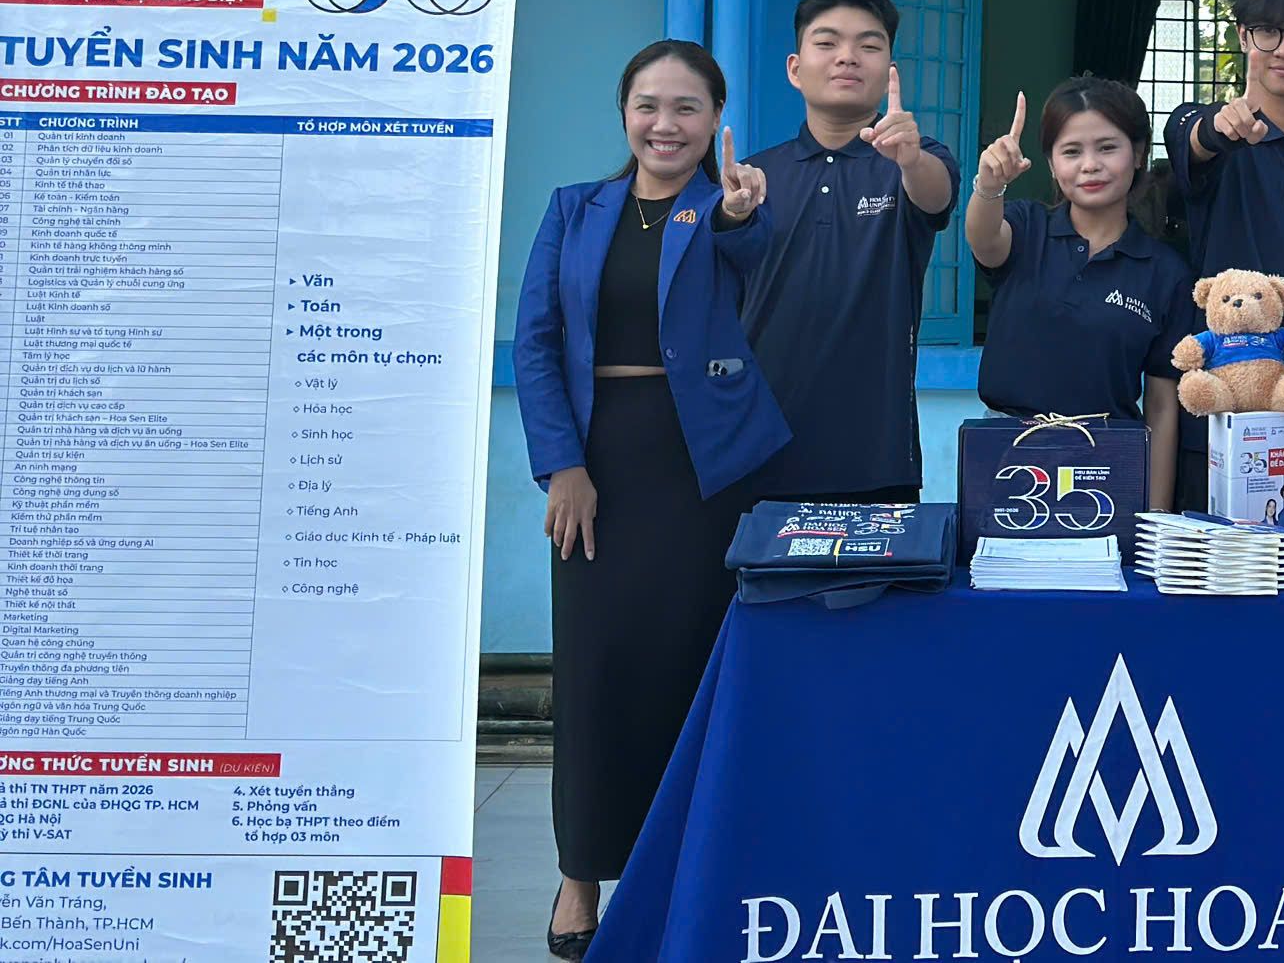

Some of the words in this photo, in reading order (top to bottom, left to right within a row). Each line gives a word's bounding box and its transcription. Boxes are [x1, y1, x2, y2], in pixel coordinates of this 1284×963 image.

[0, 26, 143, 68] TUYỂN
[158, 39, 263, 69] SINH
[278, 33, 379, 72] NĂM
[393, 43, 494, 73] 2026
[1, 83, 80, 98] CHƯƠNG
[85, 83, 140, 100] TRÌNH
[145, 84, 186, 101] ĐÀO
[191, 88, 228, 104] TẠO
[39, 117, 95, 128] CHƯƠNG
[99, 116, 139, 129] TRÌNH
[319, 121, 347, 134] HỢP
[350, 120, 382, 133] MÔN
[384, 121, 408, 133] XÉT
[302, 274, 334, 287] Văn
[301, 300, 341, 312] Toán
[299, 324, 332, 340] Một
[337, 326, 383, 341] trong
[297, 350, 325, 362] các
[331, 350, 368, 363] môn
[373, 351, 392, 367] tự
[396, 351, 442, 367] chọn:
[296, 504, 329, 518] Tiếng
[334, 506, 358, 516] Anh
[292, 583, 323, 595] Công
[327, 583, 359, 596] nghệ
[3, 613, 48, 622] Marketing
[2, 625, 31, 635] Digital
[33, 626, 79, 635] Marketing
[234, 786, 245, 796] 4.
[249, 785, 271, 797] Xét
[1, 915, 31, 929] Bến
[36, 916, 89, 932] Thành,
[93, 917, 154, 931] TP.HCM
